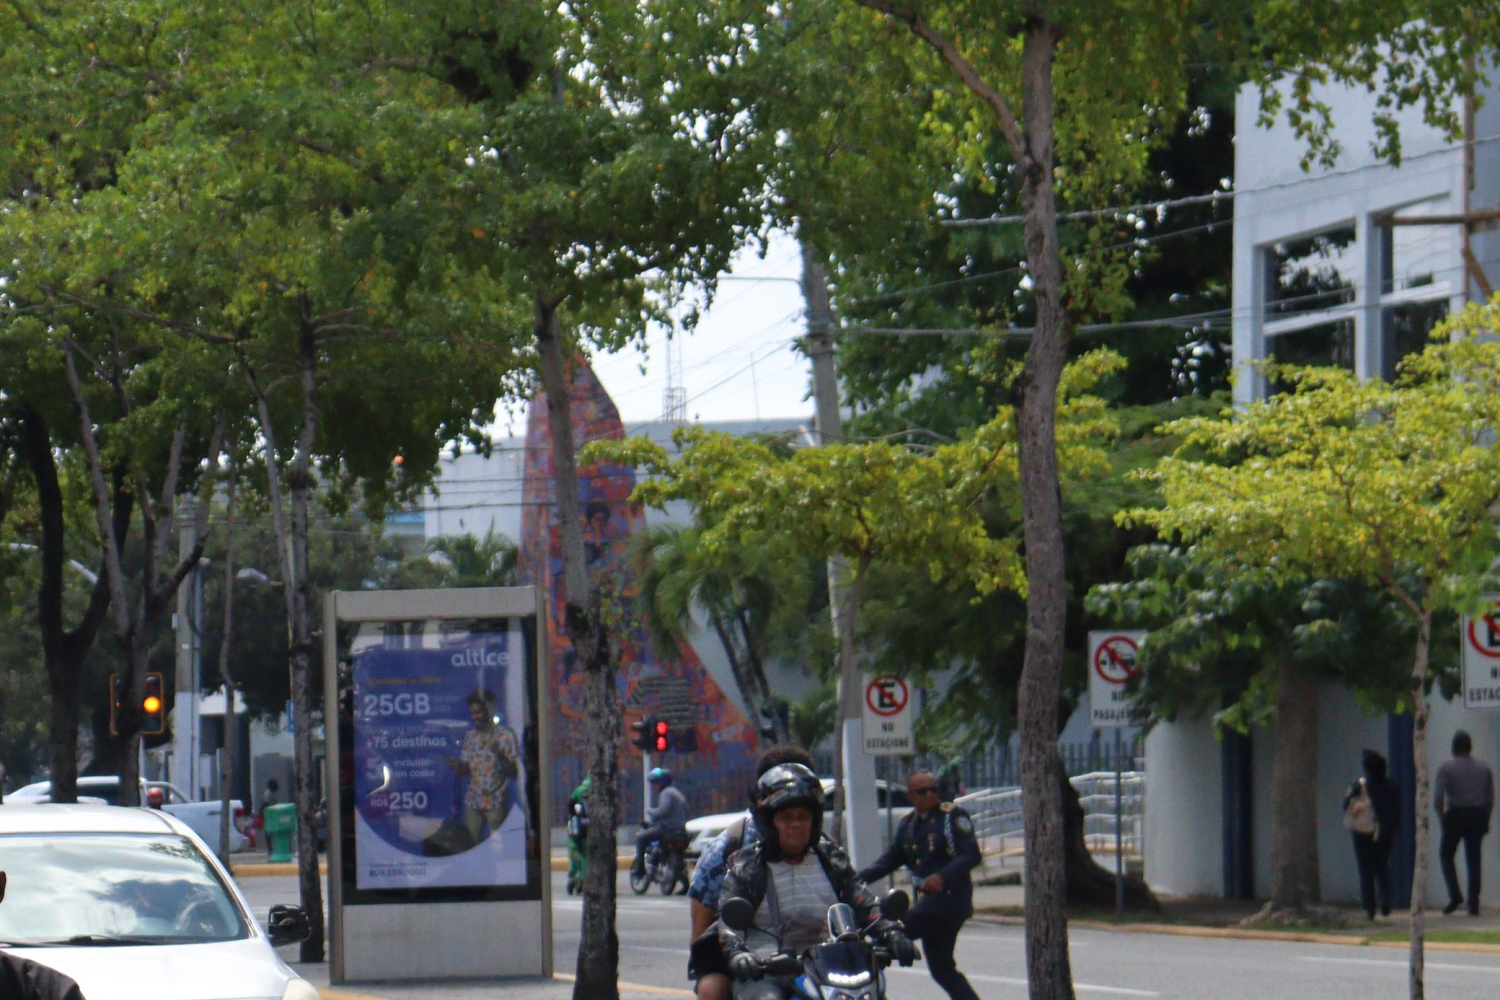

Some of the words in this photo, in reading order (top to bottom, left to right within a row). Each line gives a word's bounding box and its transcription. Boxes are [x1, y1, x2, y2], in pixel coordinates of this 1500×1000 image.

[364, 693, 430, 716] 25GB
[882, 722, 894, 732] NO
[392, 735, 447, 748] destinos
